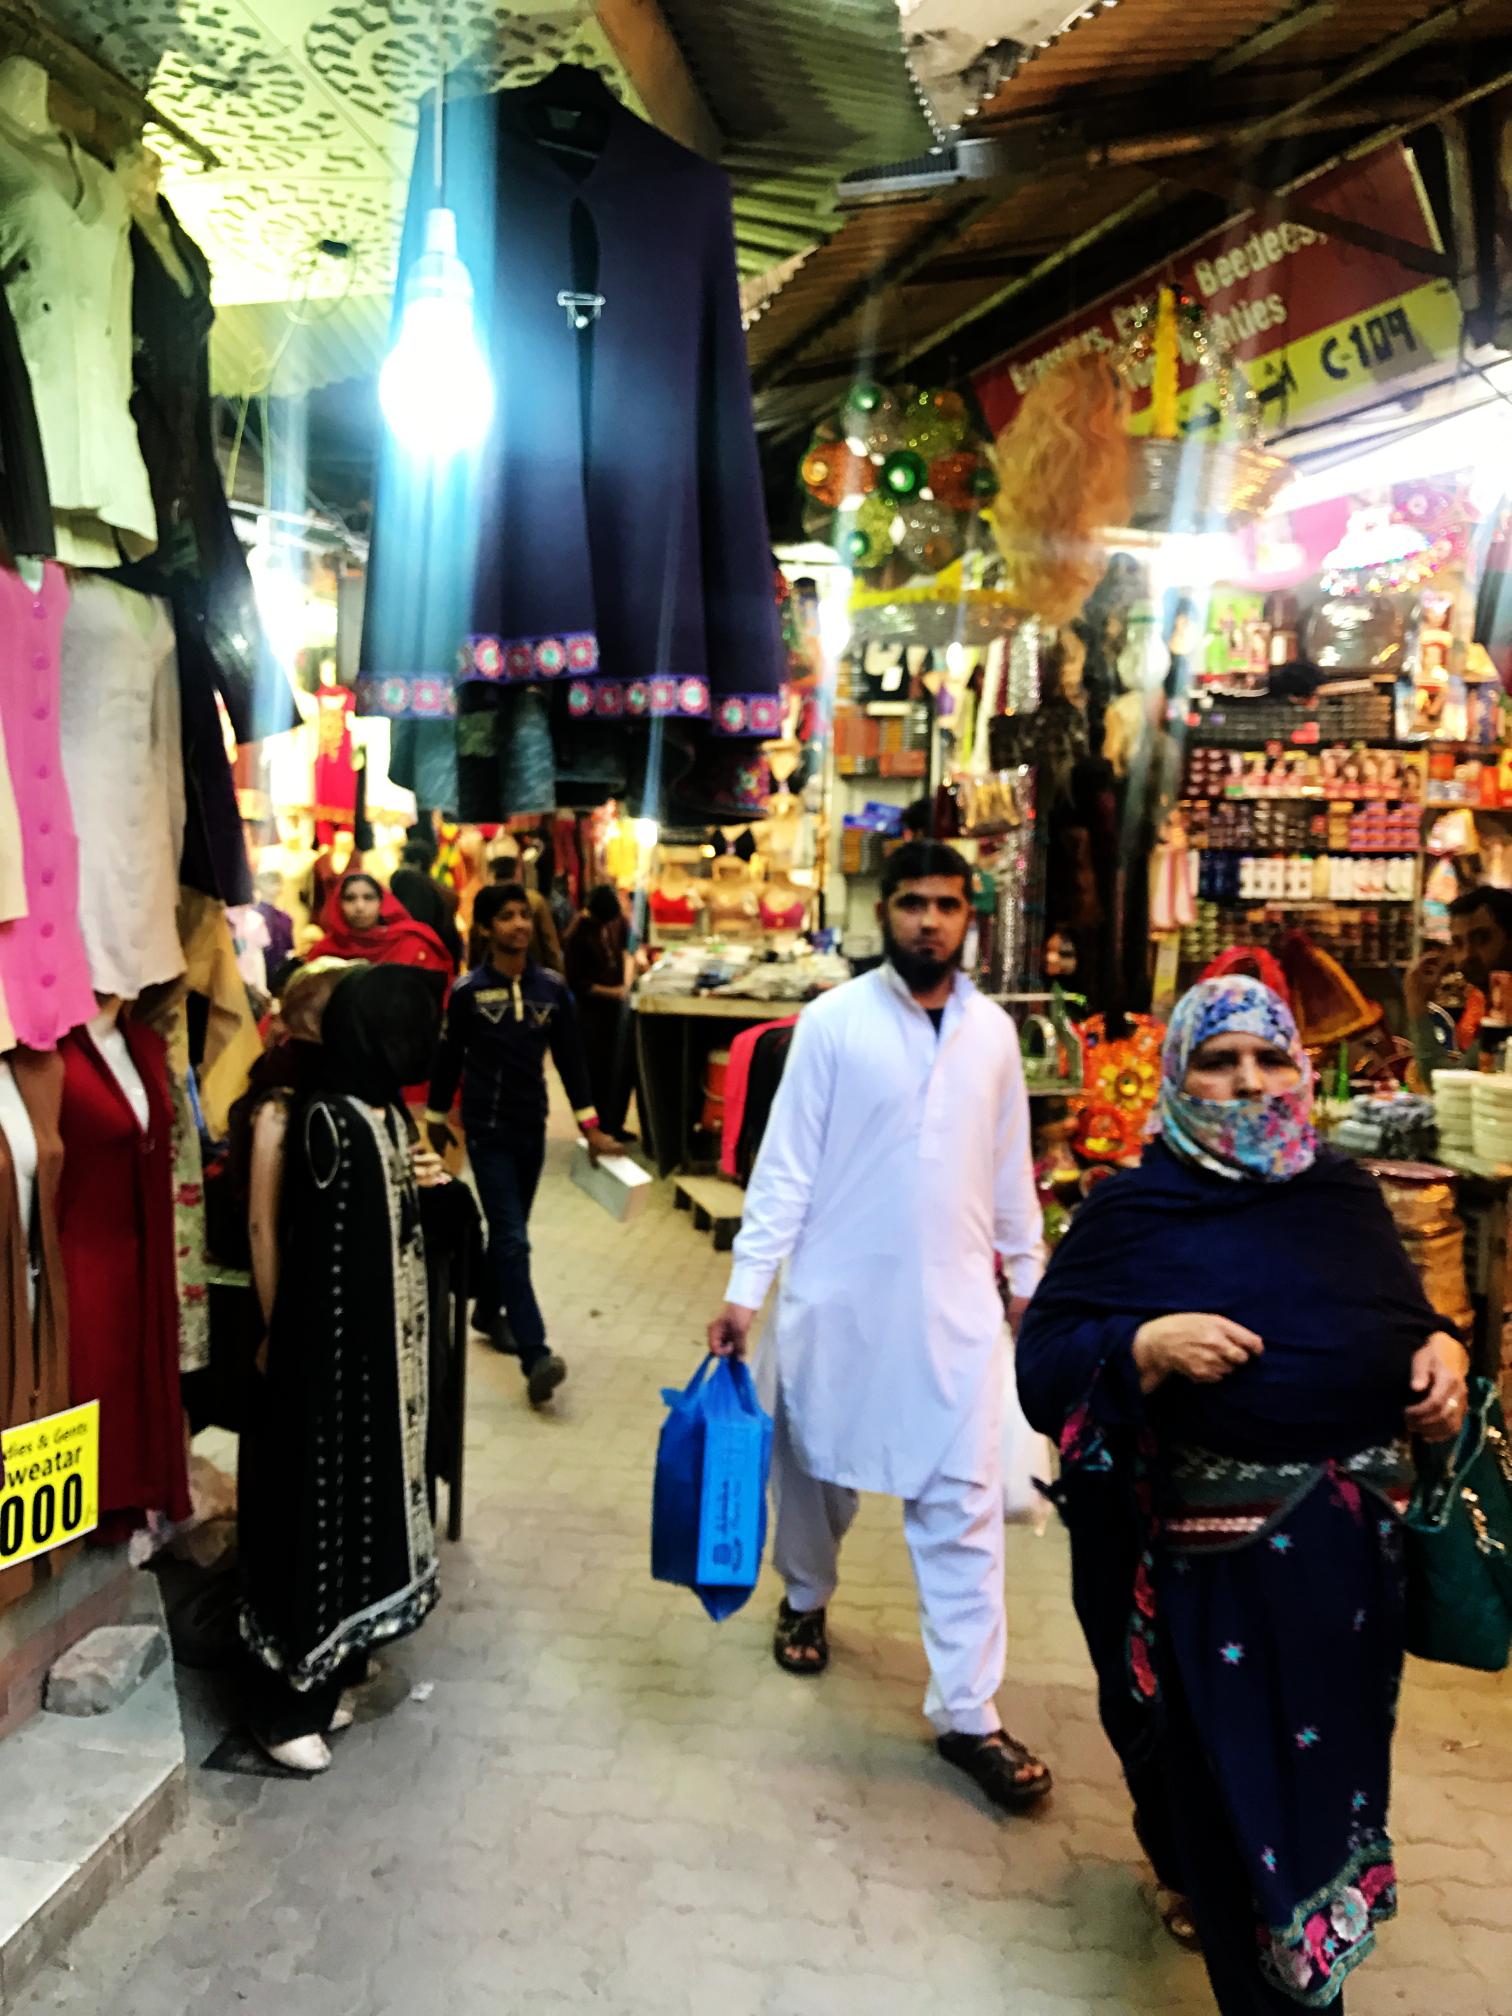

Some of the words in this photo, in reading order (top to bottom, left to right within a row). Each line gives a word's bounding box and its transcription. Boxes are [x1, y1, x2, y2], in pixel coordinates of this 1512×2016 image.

[2, 1442, 32, 1460] dies
[37, 1434, 48, 1450] &
[54, 1423, 87, 1443] Gents
[6, 1446, 81, 1488] weatar
